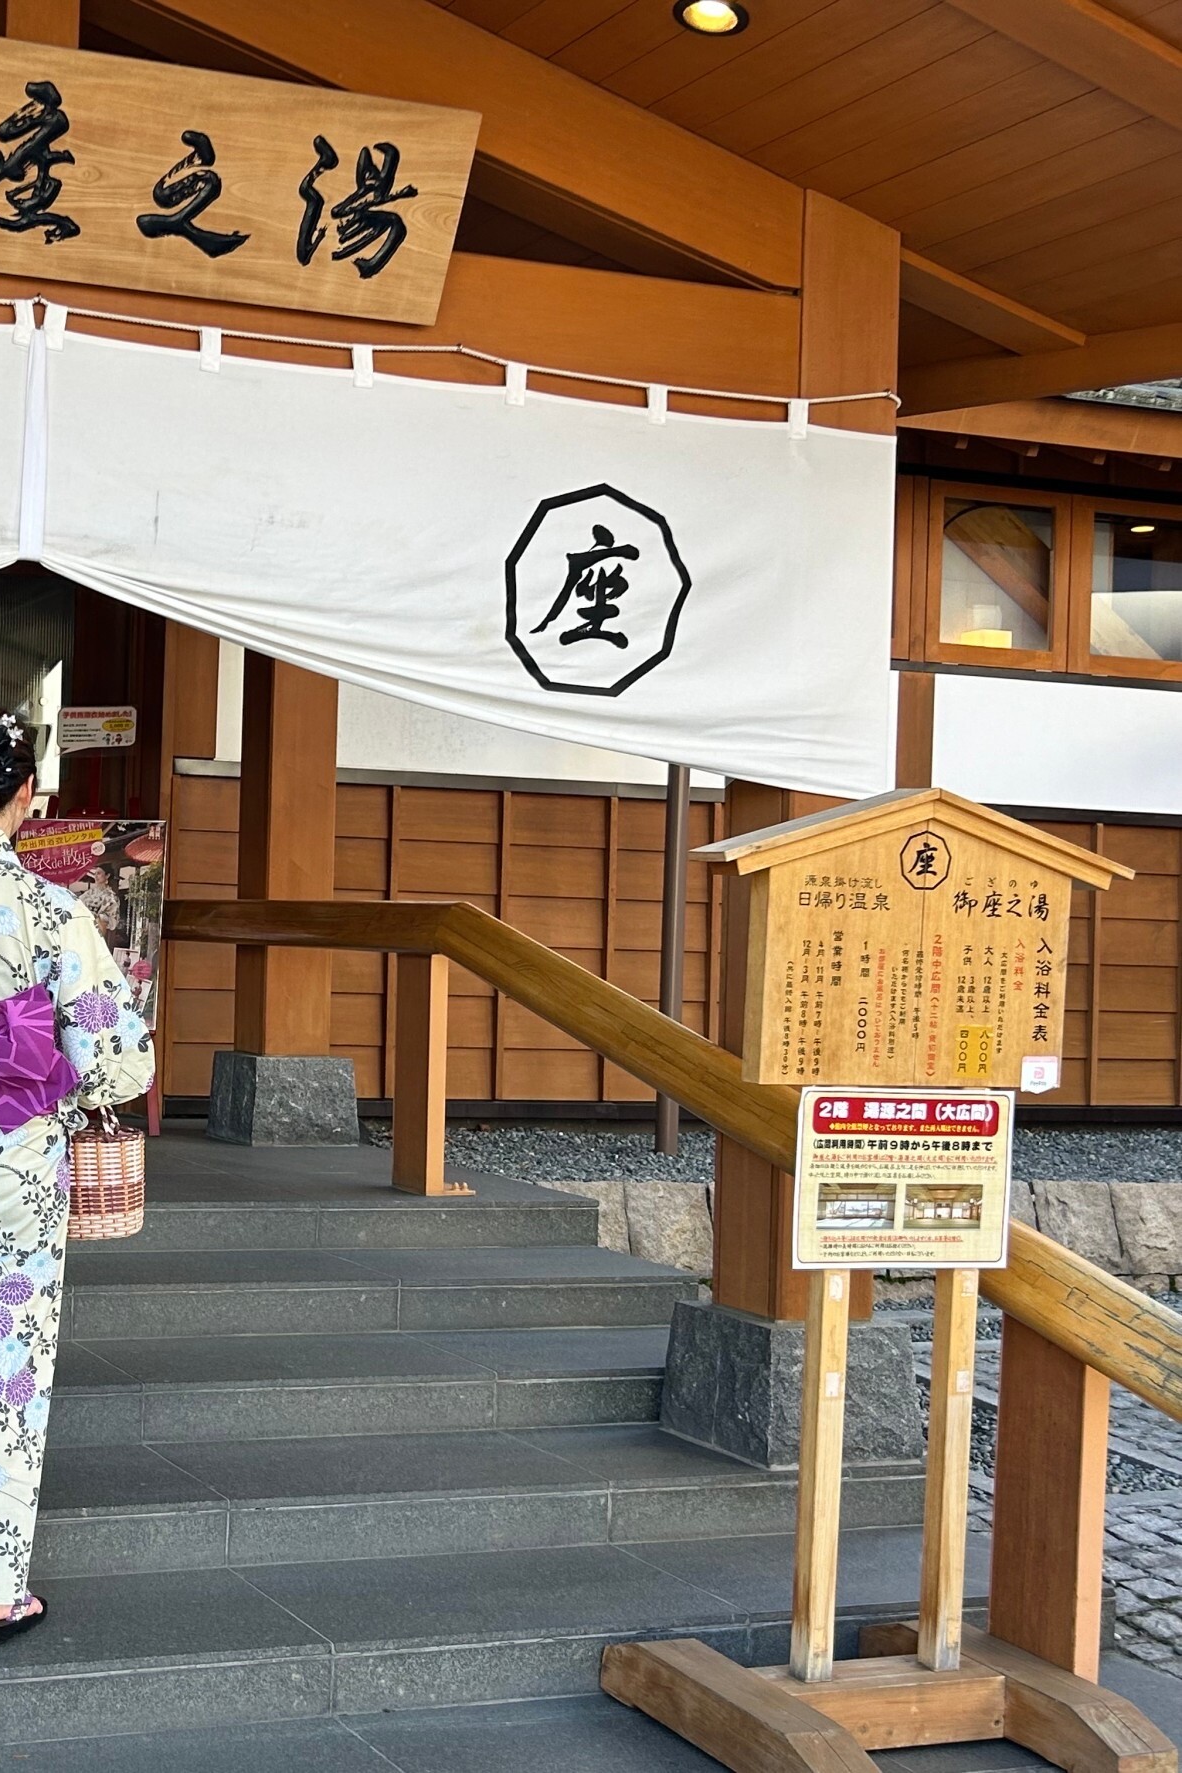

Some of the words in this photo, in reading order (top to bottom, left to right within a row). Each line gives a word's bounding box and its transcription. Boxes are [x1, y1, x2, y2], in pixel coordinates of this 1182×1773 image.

[529, 524, 640, 650] 座
[908, 843, 938, 877] 座
[804, 875, 883, 889] 源泉掛け流し
[798, 891, 891, 912] 日帰り温泉
[952, 890, 1050, 922] 御座之湯
[830, 930, 844, 986] 営業時間
[963, 945, 974, 966] 子供
[984, 945, 995, 966] 大人
[1013, 938, 1026, 991] 入浴料金
[981, 976, 992, 1013] 12歳以上
[1031, 937, 1053, 1042] 入浴料金表
[819, 1102, 849, 1118] 2階
